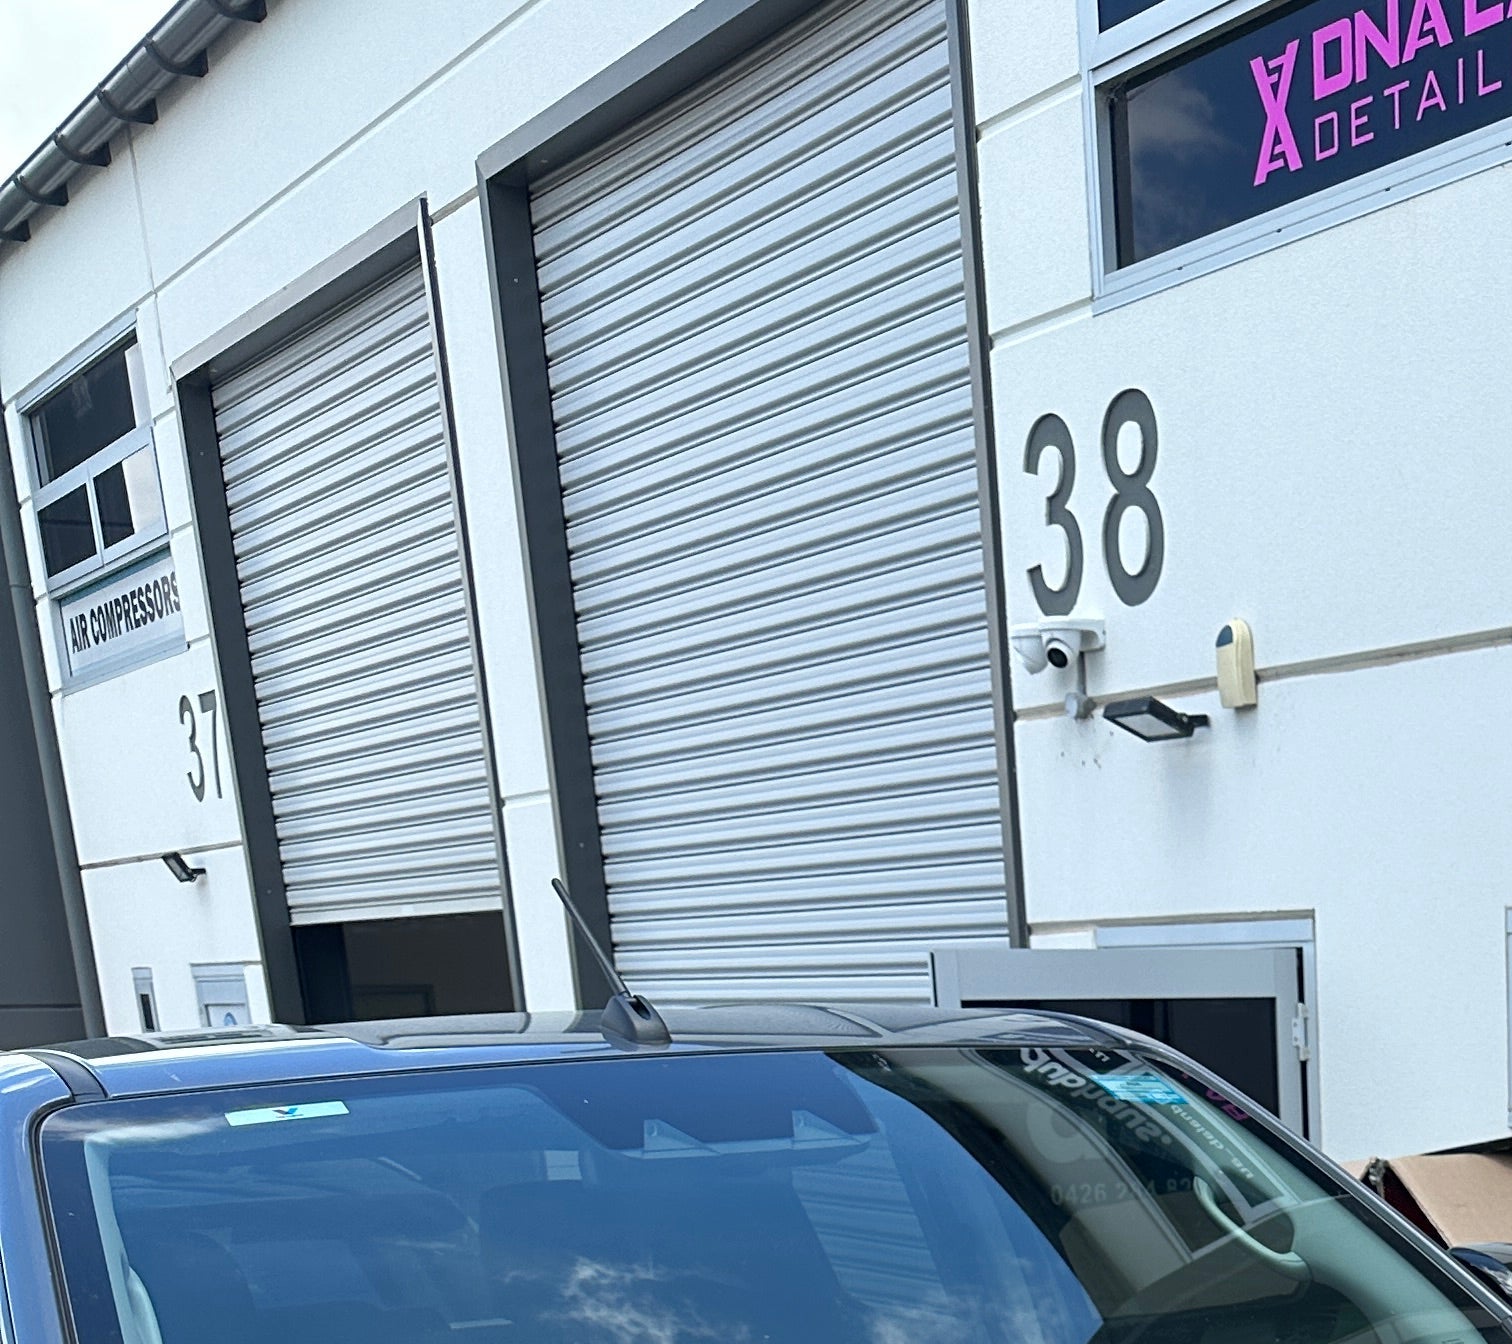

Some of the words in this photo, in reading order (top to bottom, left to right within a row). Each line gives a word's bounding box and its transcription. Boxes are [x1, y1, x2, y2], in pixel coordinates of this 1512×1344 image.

[1312, 0, 1453, 100] DNA
[1023, 388, 1165, 616] 38
[69, 613, 92, 654] AIR
[90, 571, 181, 645] COMPRESSORS
[179, 689, 223, 803] 37
